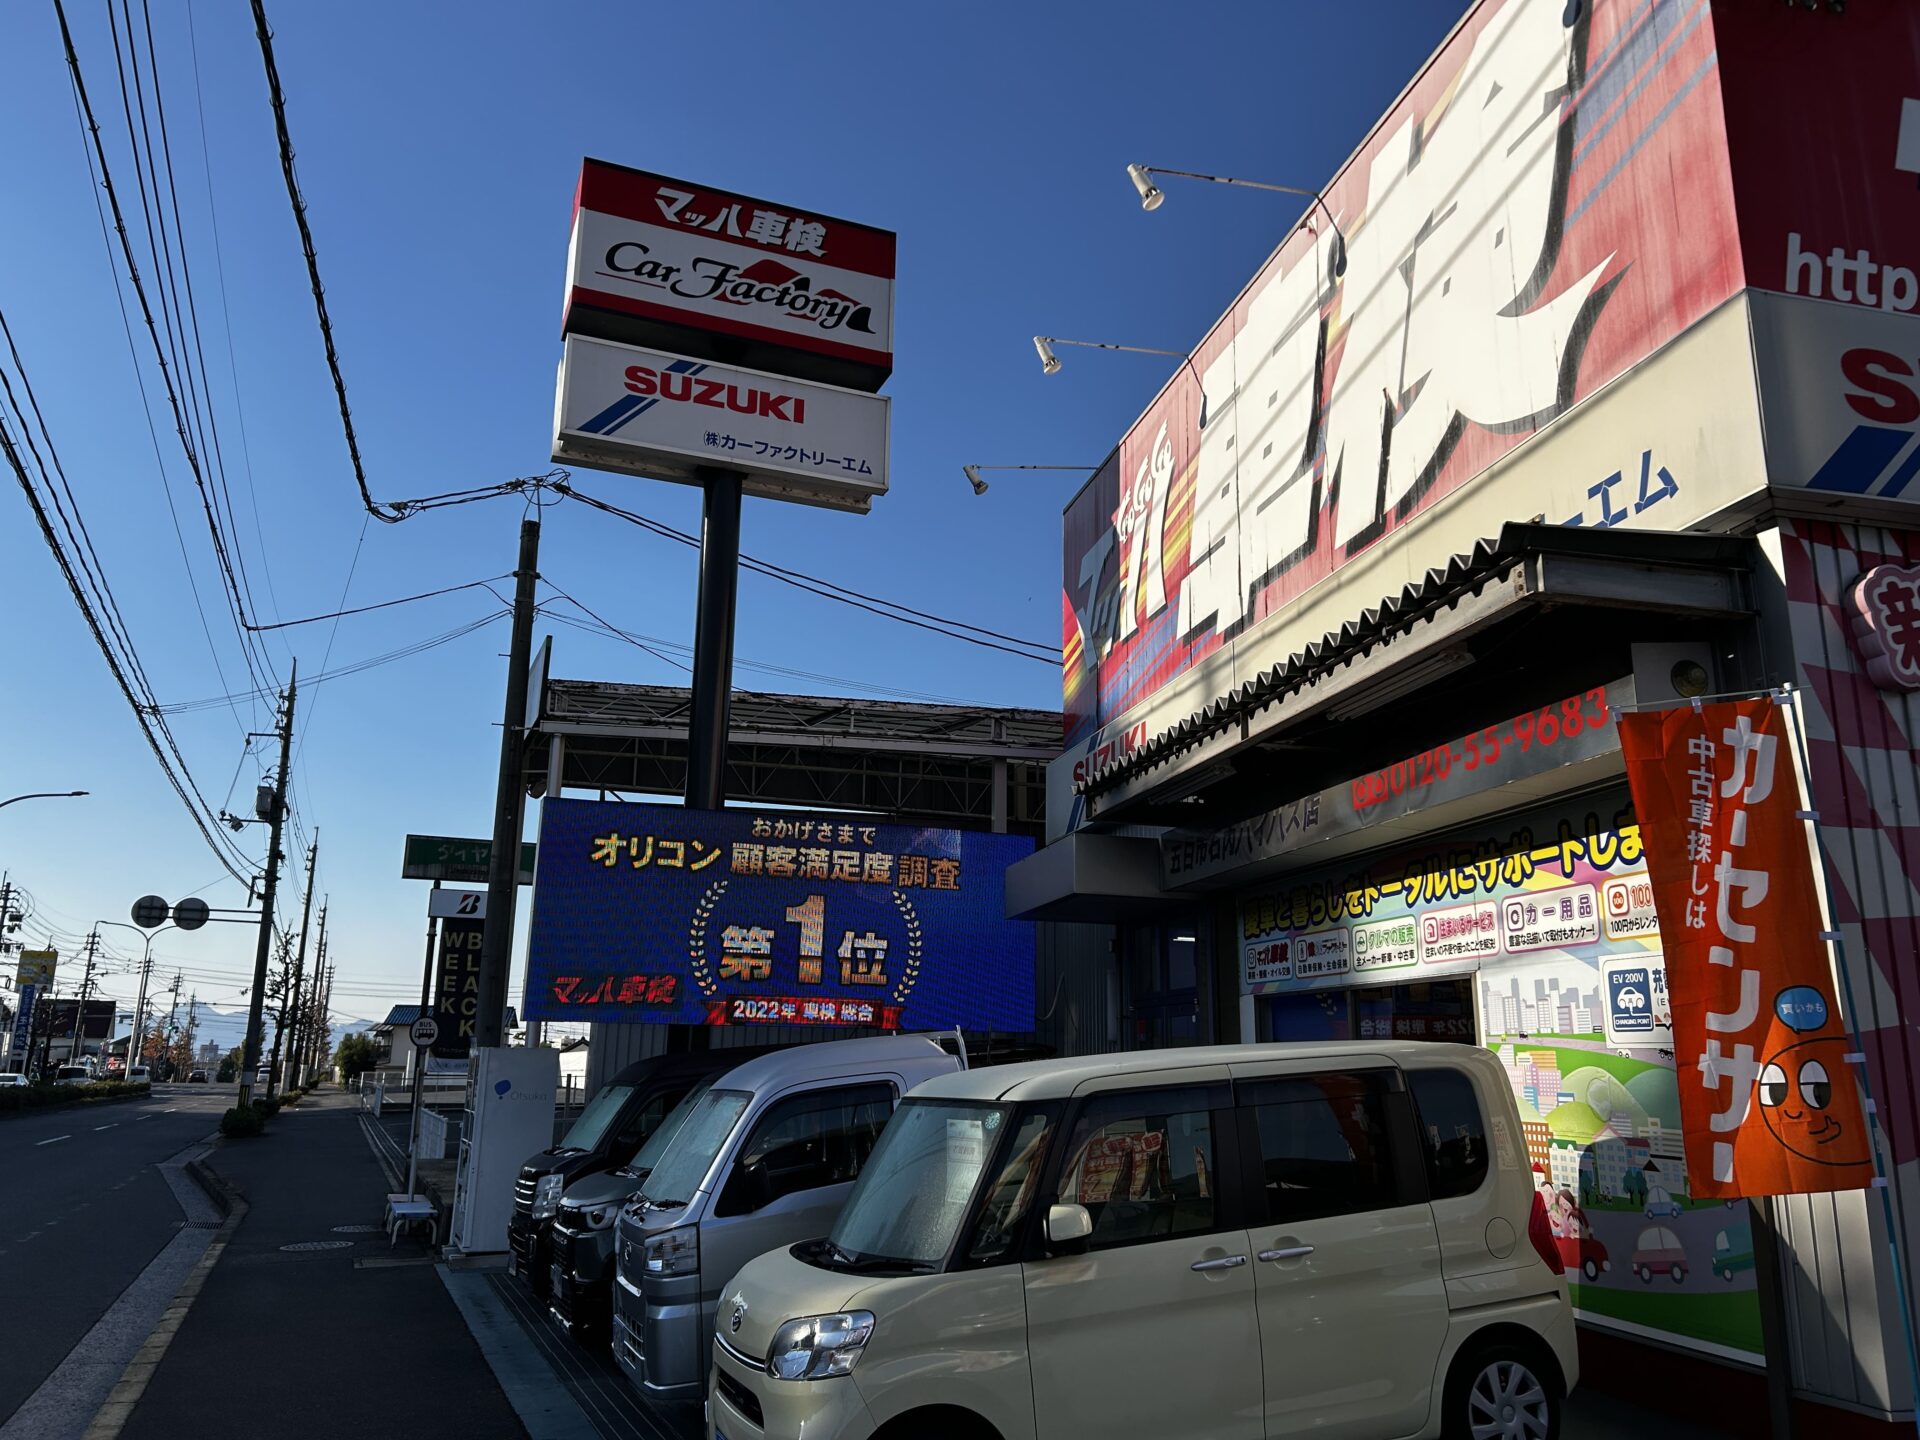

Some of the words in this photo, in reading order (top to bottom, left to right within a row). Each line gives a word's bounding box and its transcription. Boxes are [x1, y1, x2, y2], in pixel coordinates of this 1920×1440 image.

[654, 186, 828, 258] マッハ車検
[604, 241, 681, 283] Car
[670, 256, 850, 330] Factory
[623, 365, 805, 425] SUZUKI
[1841, 347, 1920, 424] S
[1389, 686, 1609, 796] 0120-55-9683
[751, 816, 877, 846] おかげさまで
[1685, 734, 1717, 930] 中古車探しは
[590, 832, 723, 872] オリコン
[730, 841, 962, 891] 顧客満足度調査
[1368, 923, 1415, 950] クルマの販売
[1439, 910, 1496, 940] 住まいるサービス
[1525, 892, 1593, 926] カー用品
[718, 894, 889, 986] 第1位
[1697, 715, 1778, 1184] カーセンサー
[440, 931, 465, 1014] WEEK
[458, 932, 482, 1038] BLACK
[551, 974, 677, 1004] マッハ車検
[1613, 974, 1624, 984] EV
[1625, 972, 1644, 983] 200V
[733, 999, 797, 1020] 2022年
[1780, 1002, 1824, 1016] 買いかも
